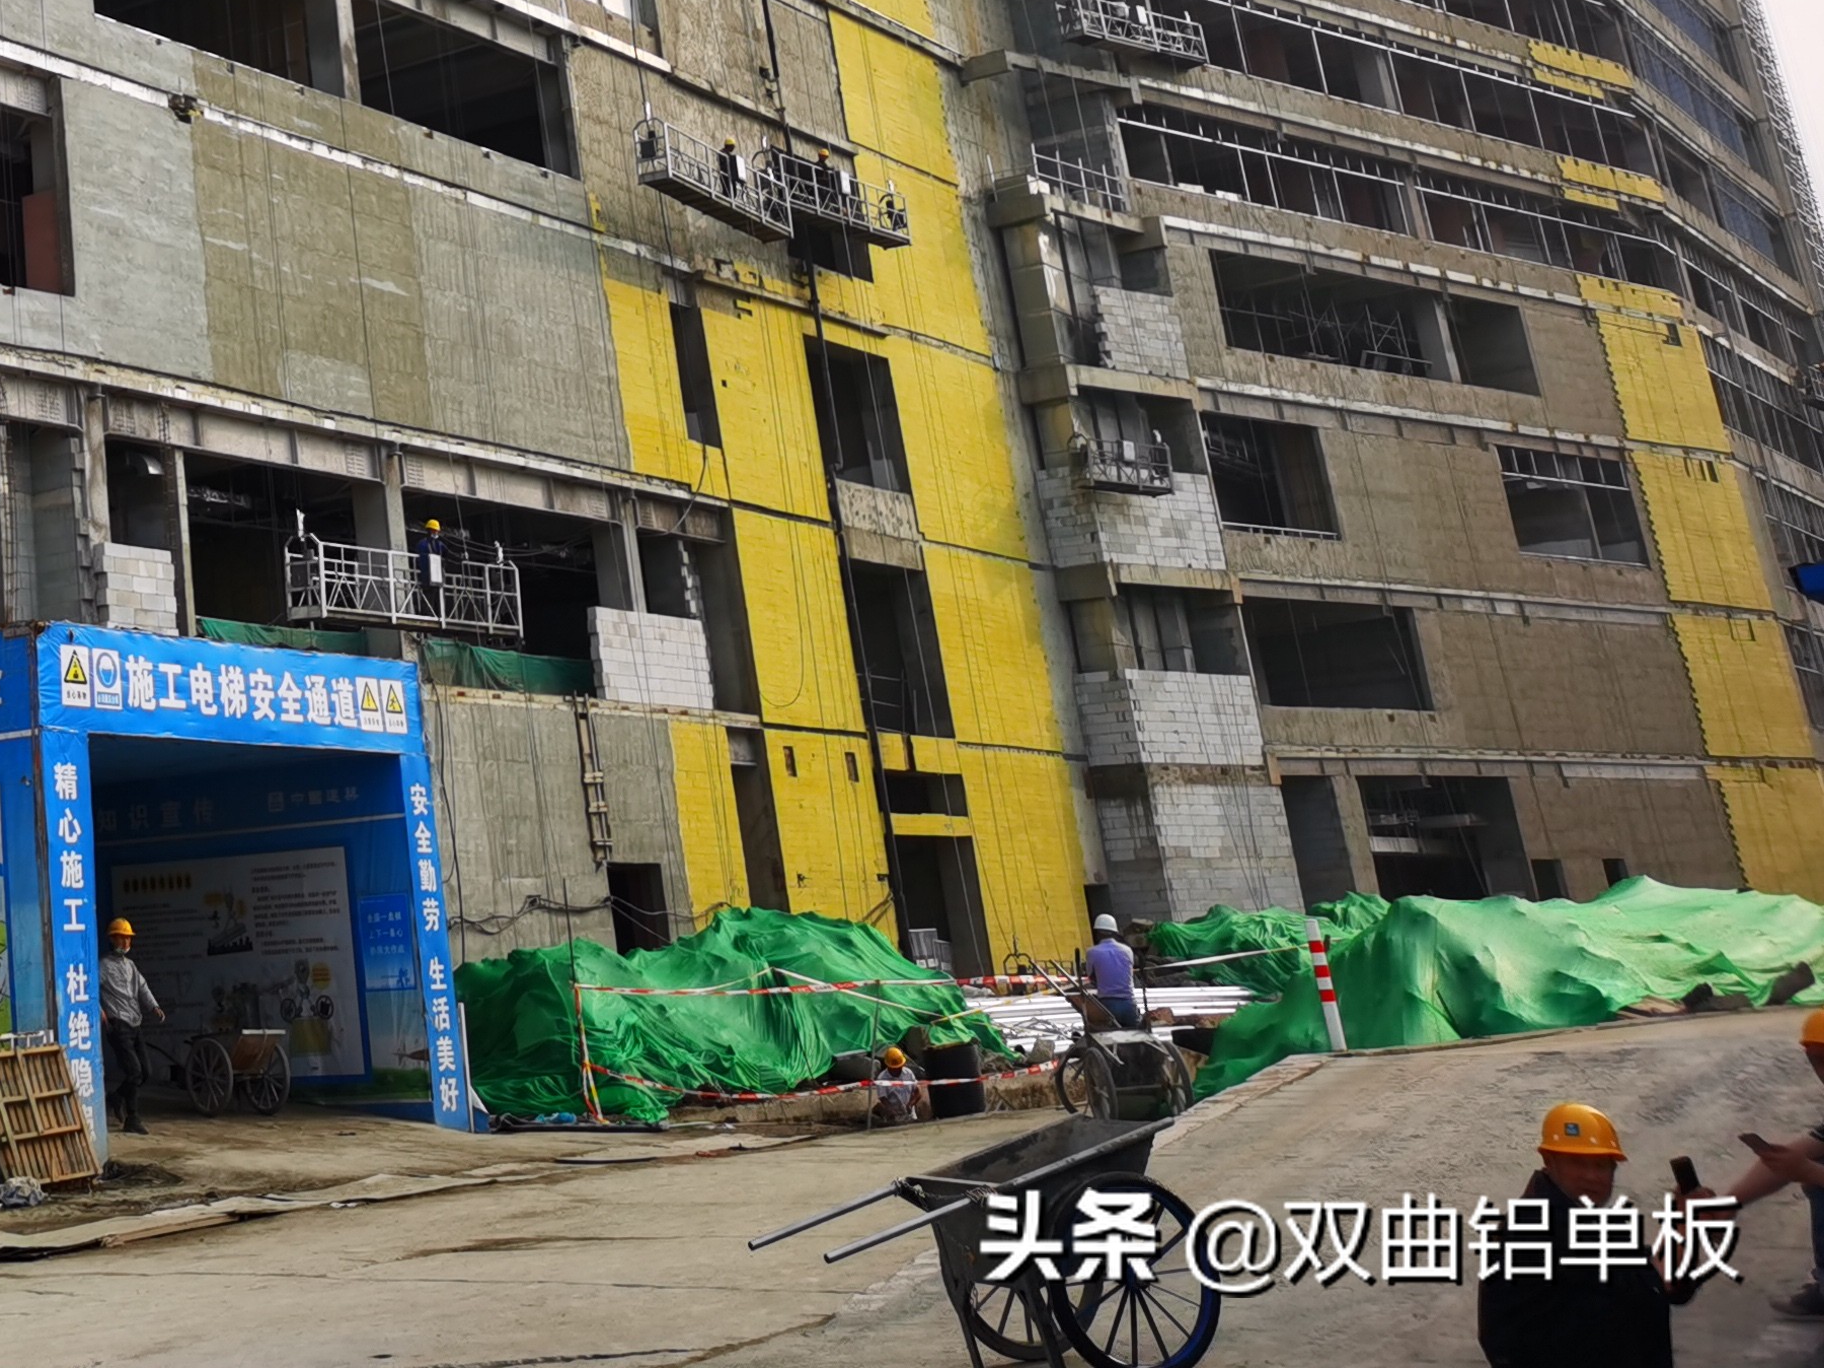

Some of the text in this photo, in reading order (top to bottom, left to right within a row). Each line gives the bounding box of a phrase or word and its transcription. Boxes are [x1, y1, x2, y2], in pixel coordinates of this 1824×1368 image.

[125, 654, 358, 728] 施工电梯安全通道
[53, 761, 86, 932] 精心施工
[409, 783, 440, 933] 安全勤劳
[429, 955, 460, 1113] 生活美好
